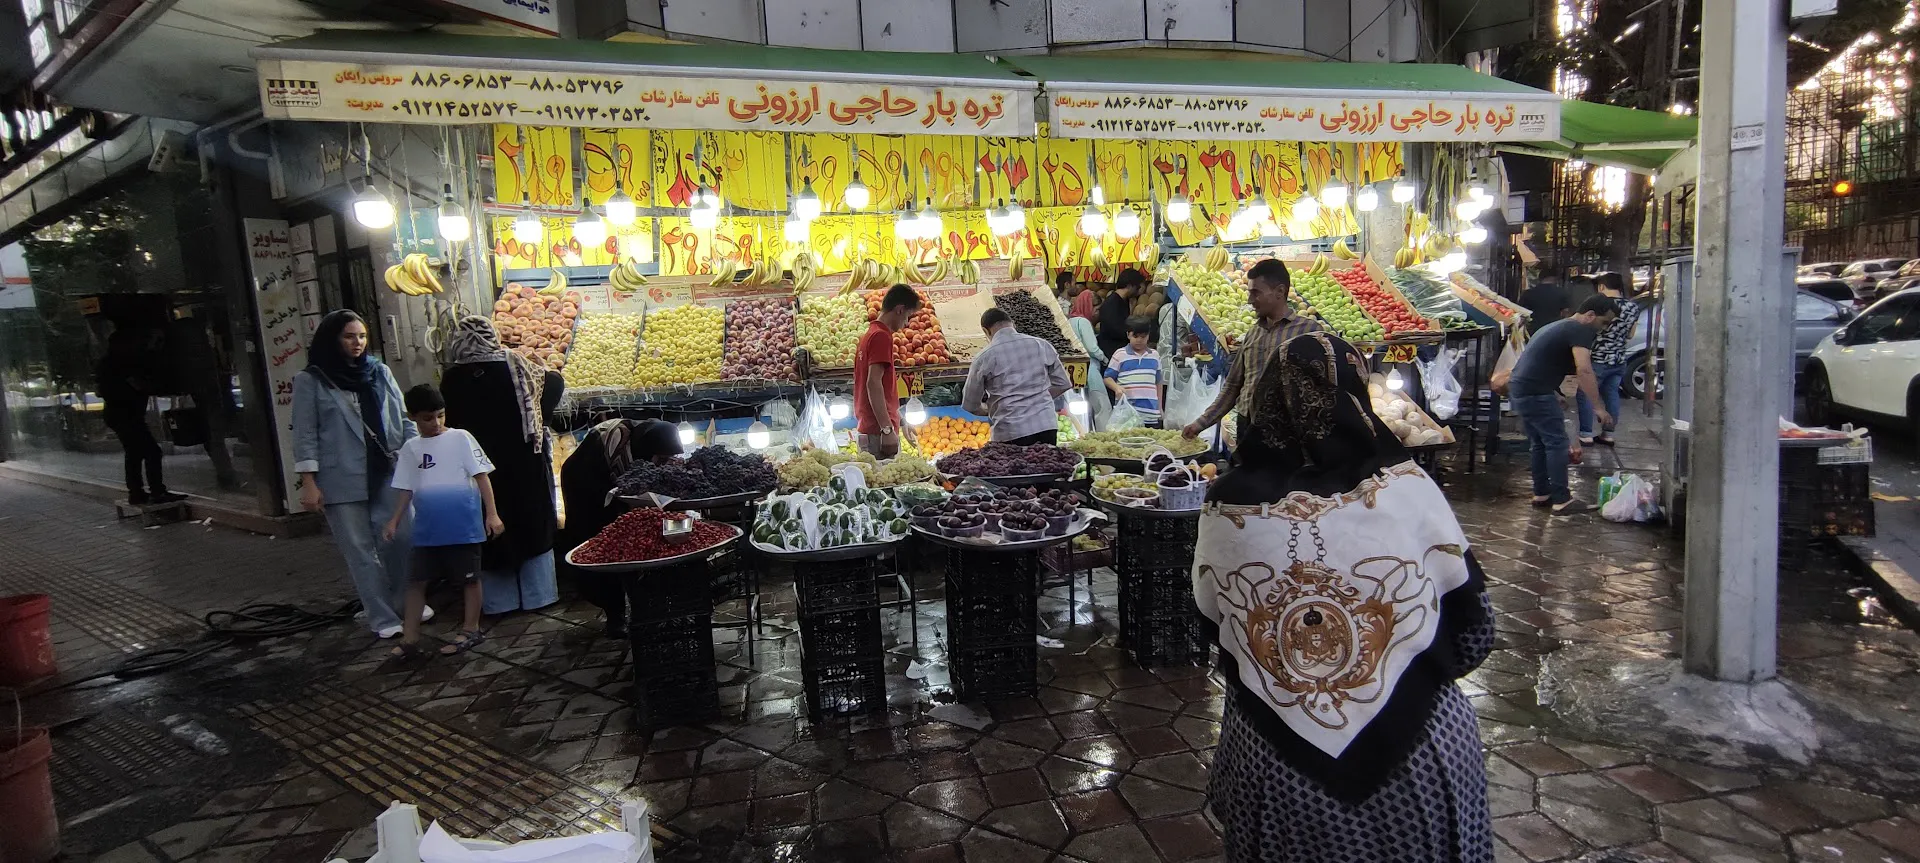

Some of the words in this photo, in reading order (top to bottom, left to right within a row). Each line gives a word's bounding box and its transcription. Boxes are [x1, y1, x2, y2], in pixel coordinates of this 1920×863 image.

[335, 71, 366, 84] رایگان
[368, 75, 403, 85] سرویس
[696, 91, 720, 108] تلفن
[728, 84, 821, 125] ارزونی
[829, 88, 917, 124] حاجی
[921, 90, 957, 127] بار
[963, 93, 1004, 128] تره
[1055, 97, 1075, 107] رایگان
[1076, 99, 1099, 108] سرویس
[1297, 107, 1314, 121] تلفن
[1320, 101, 1384, 133] ارزونی
[1391, 103, 1451, 132] حاجی
[1455, 104, 1480, 134] بار
[1485, 106, 1514, 135] تره
